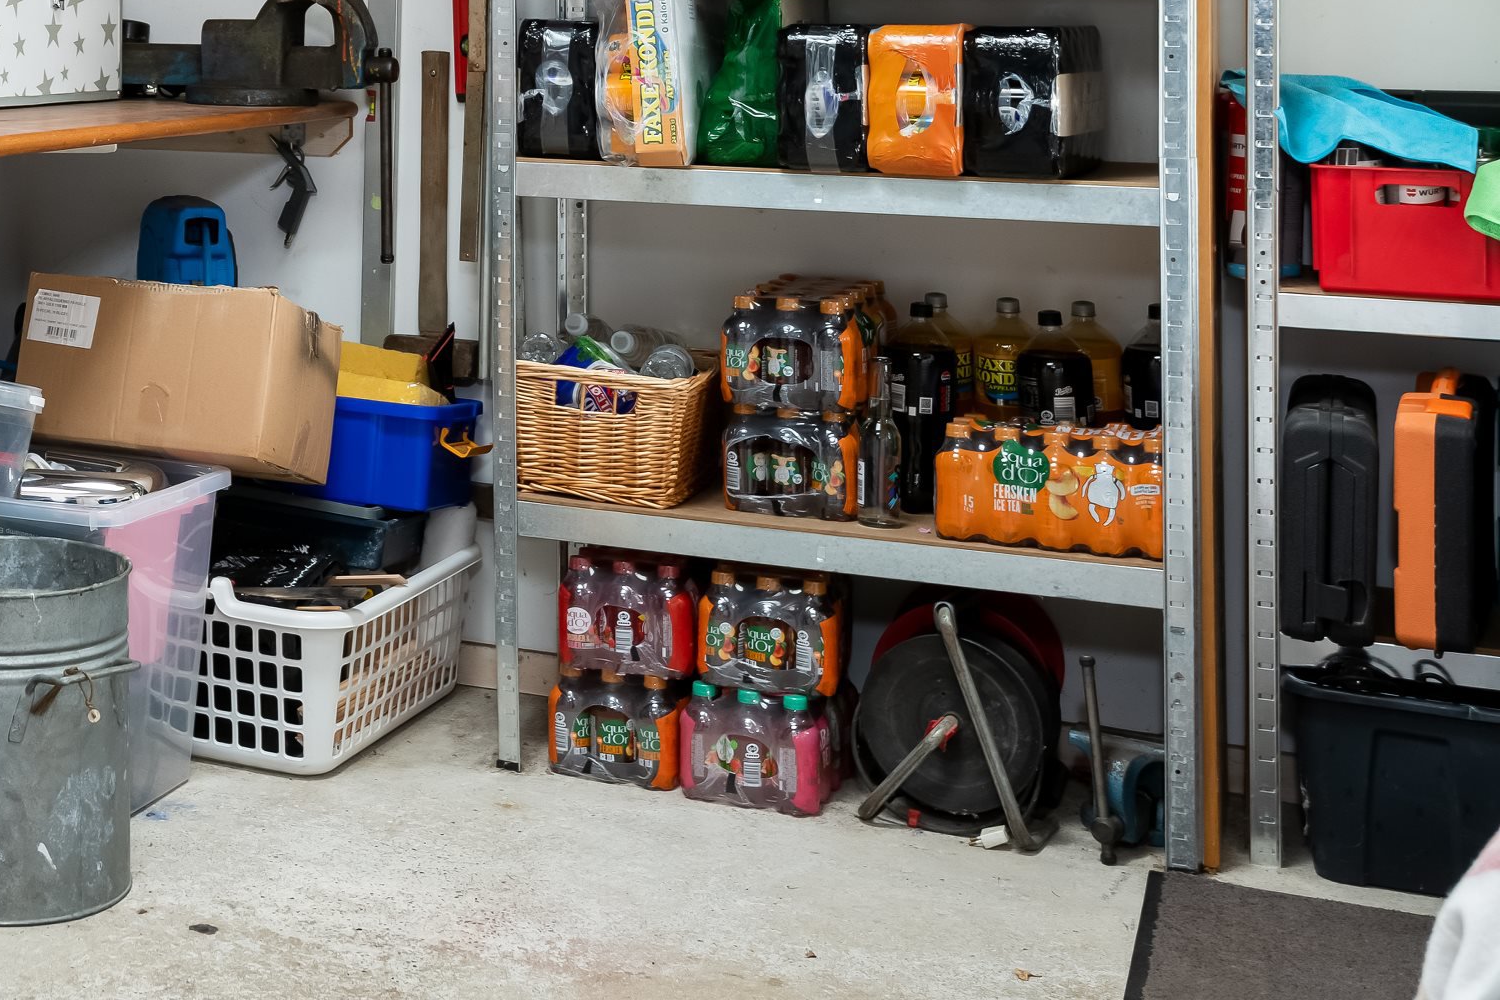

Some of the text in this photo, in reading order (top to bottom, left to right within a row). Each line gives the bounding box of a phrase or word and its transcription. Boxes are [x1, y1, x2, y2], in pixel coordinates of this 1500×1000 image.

[634, 0, 664, 145] FAXE KONDI
[978, 355, 1016, 372] FAXE
[975, 370, 1017, 385] KOND
[963, 494, 974, 508] 15
[993, 483, 1038, 503] FERSKEN
[993, 499, 1021, 513] ICE TEA
